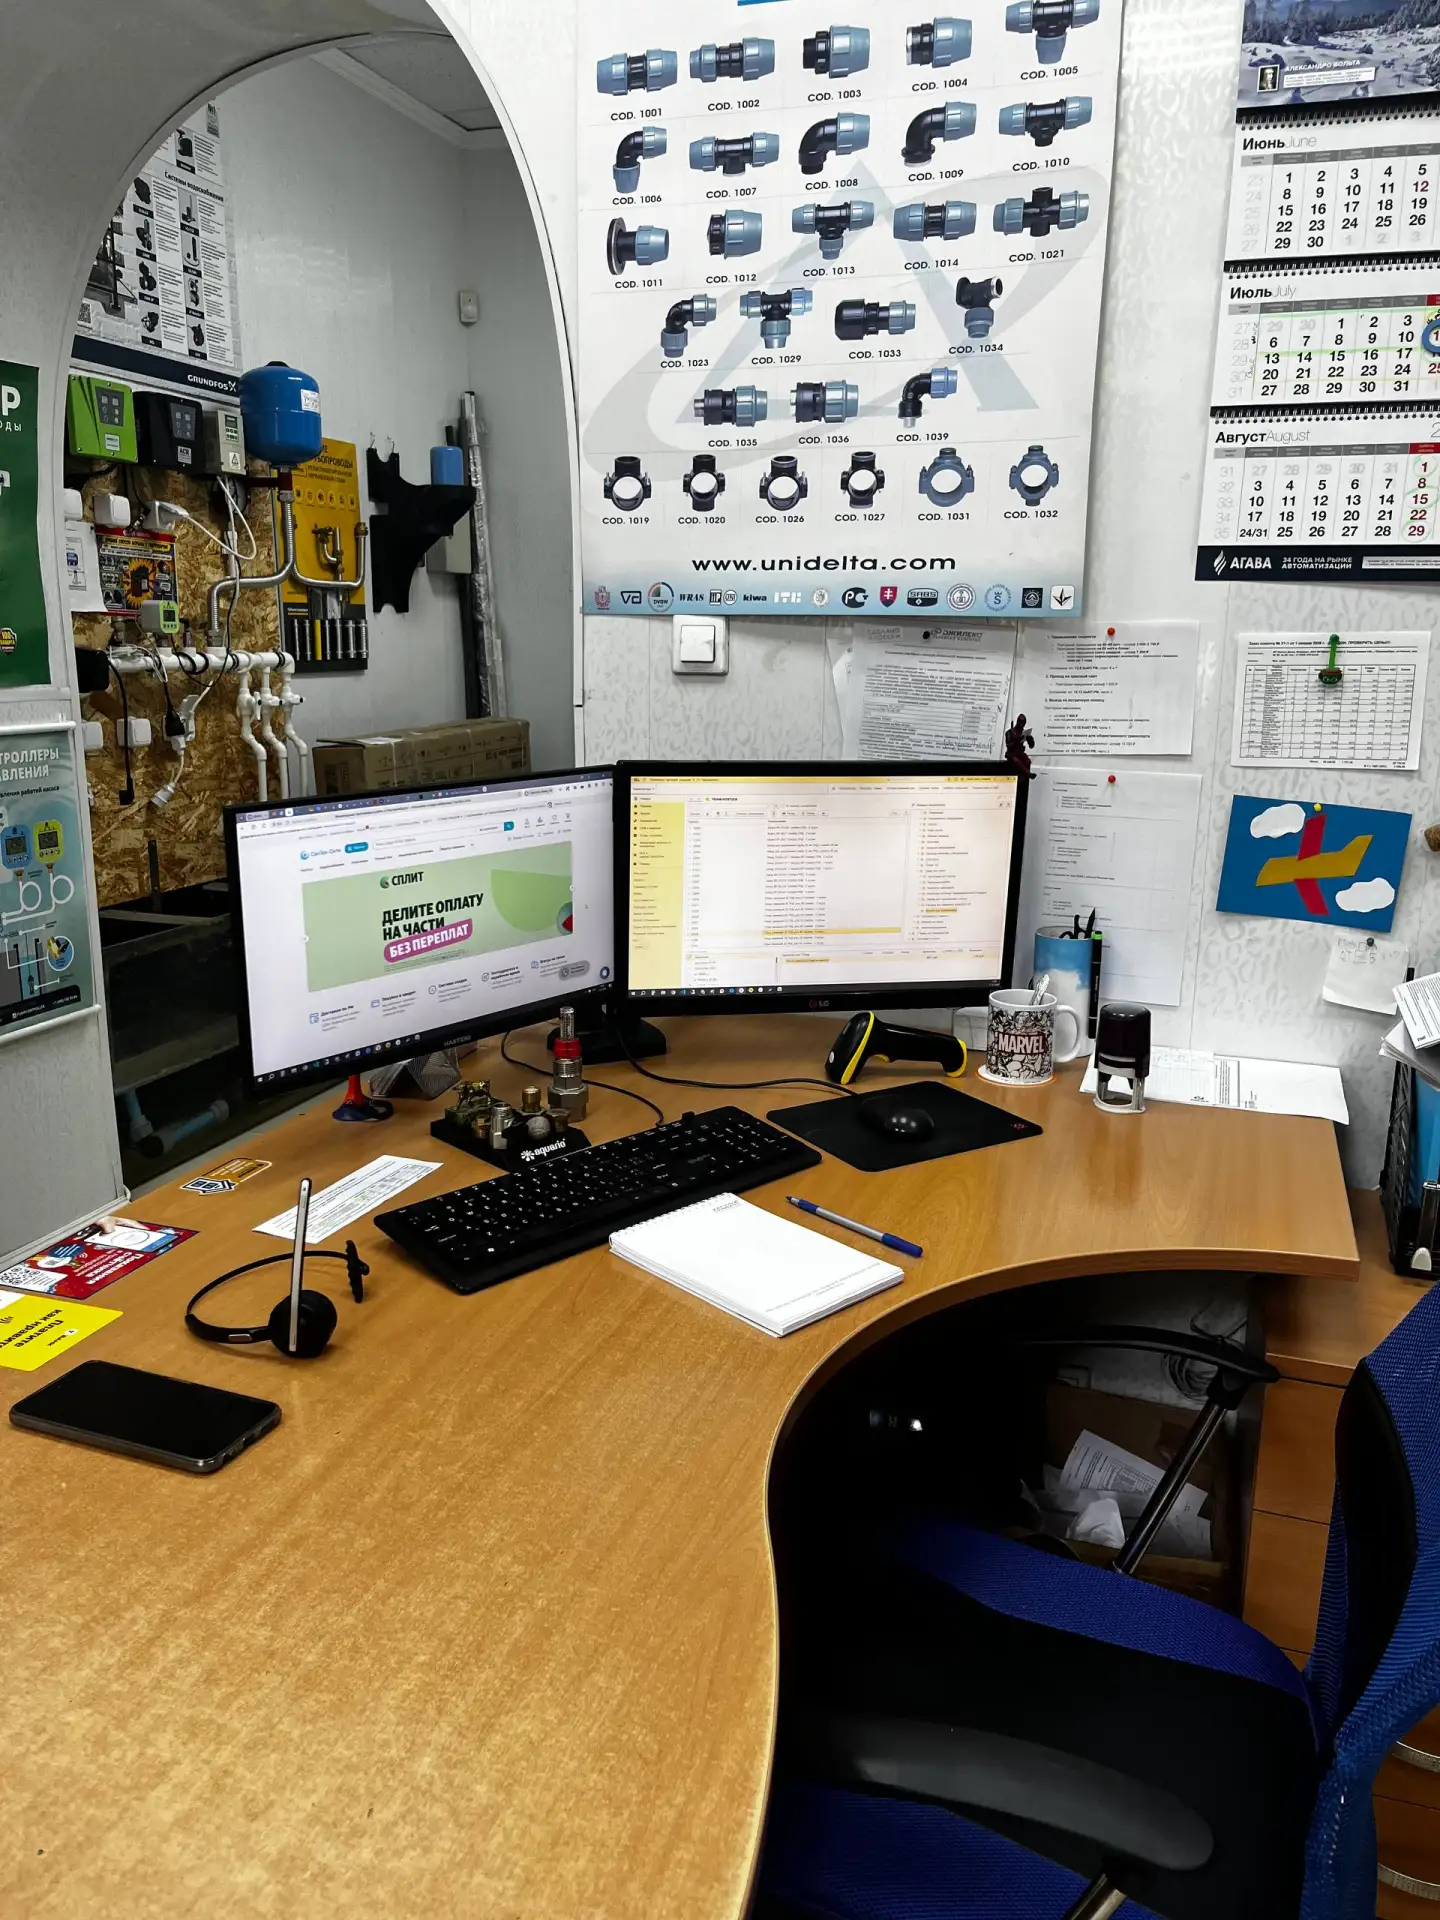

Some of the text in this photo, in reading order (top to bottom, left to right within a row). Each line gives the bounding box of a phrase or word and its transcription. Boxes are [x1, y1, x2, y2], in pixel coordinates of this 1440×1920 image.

[1021, 66, 1078, 80] COD. 1005
[1284, 64, 1332, 72] АЛЕКСАНДРО
[912, 78, 967, 91] COD. 1004
[808, 90, 861, 102] COD. 1003
[708, 100, 759, 111] COD. 1002
[611, 108, 661, 120] COD. 1001
[1242, 136, 1317, 150] Июнь June
[1012, 158, 1069, 171] COD. 1010
[908, 170, 963, 181] COD. 1009
[1286, 164, 1426, 183] 1 2 3 4 5
[806, 179, 858, 190] COD. 1008
[1283, 181, 1428, 199] 8 9 10 11 12
[706, 188, 756, 198] COD. 1007
[612, 195, 661, 205] COD. 1006
[1278, 198, 1427, 216] 15 16 17 18 19
[1276, 214, 1426, 232] 22 23 24 25 26
[1274, 236, 1323, 249] 29 30
[1009, 250, 1064, 262] COD. 1021
[904, 259, 958, 270] COD. 1014
[803, 266, 854, 277] COD. 1013
[643, 279, 662, 287] 1011
[706, 274, 756, 284] COD. 1012
[1230, 285, 1296, 299] Июль July
[1338, 315, 1412, 328] 1 2 3
[1270, 331, 1414, 348] 6 7 8 9 10
[849, 351, 873, 359] COD.
[949, 344, 1003, 354] COD. 1034
[780, 355, 801, 363] 1029
[187, 373, 228, 391] GRUNDFOS
[799, 436, 822, 444] COD.
[896, 434, 921, 442] COD.
[1215, 429, 1310, 445] Август August
[1422, 462, 1427, 472] 1
[1254, 478, 1426, 491] 3 4 5 6 7 8
[1250, 494, 1428, 506] 10 11 12 13 14 15
[1035, 510, 1058, 518] 1032
[1248, 510, 1426, 522] 17 18 19 20 21 22
[1240, 526, 1424, 537] 24/31 25 26 27 28 29
[692, 556, 955, 570] www.unidelta.com
[1230, 557, 1272, 569] АГАВА
[743, 594, 767, 602] kiwa
[391, 871, 424, 886] СПЛИТ
[382, 893, 484, 927] ДЕЛИТЕ ОПЛАТУ
[383, 917, 445, 941] НА ЧАСТИ
[389, 924, 469, 958] БЕЗ ПЕРЕПЛАТ
[998, 1033, 1045, 1054] MARVEL
[534, 1139, 566, 1157] aquario
[40, 1309, 62, 1322] как
[14, 1319, 64, 1348] Платите
